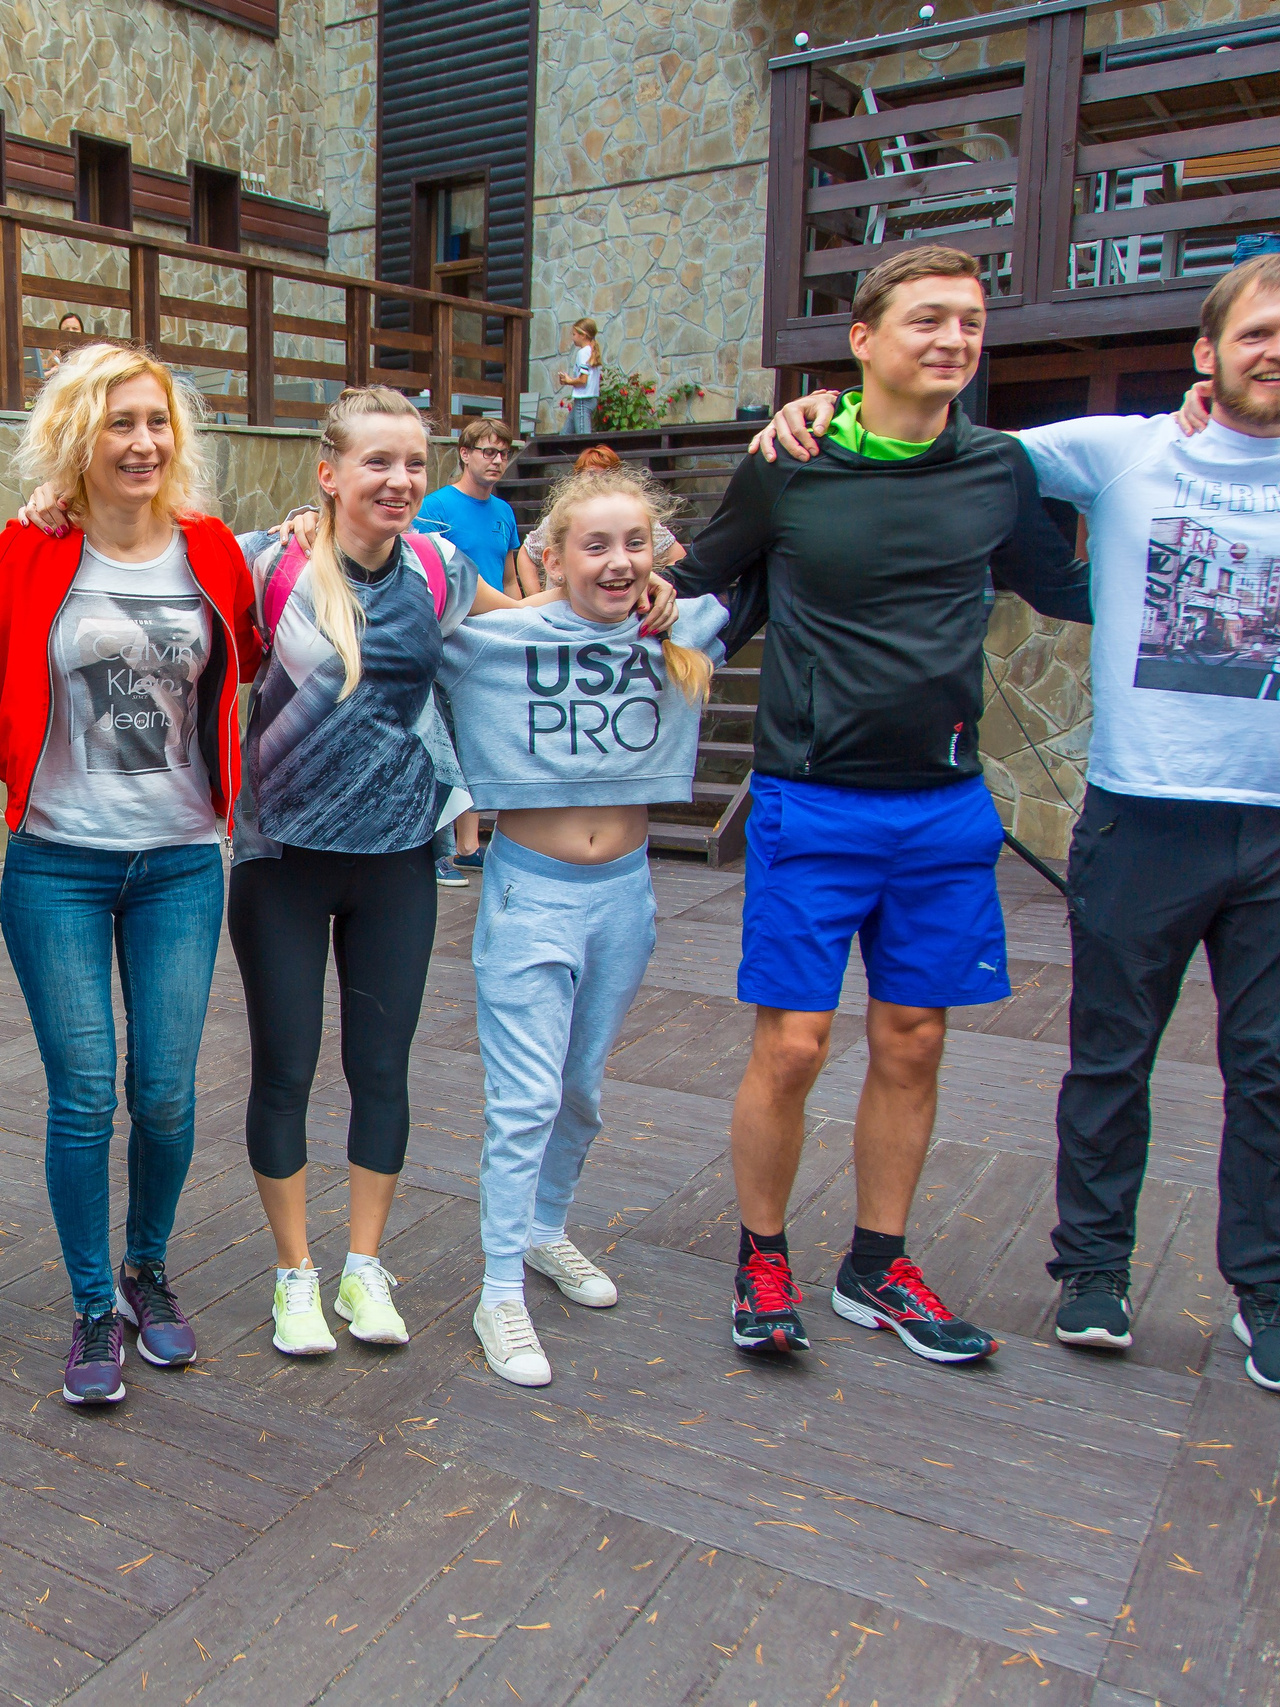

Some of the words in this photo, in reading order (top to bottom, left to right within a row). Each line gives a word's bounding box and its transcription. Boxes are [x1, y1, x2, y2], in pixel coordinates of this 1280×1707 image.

[92, 634, 193, 664] Calvin
[525, 643, 663, 697] USA
[528, 697, 661, 755] PRO
[949, 733, 960, 766] Reebok
